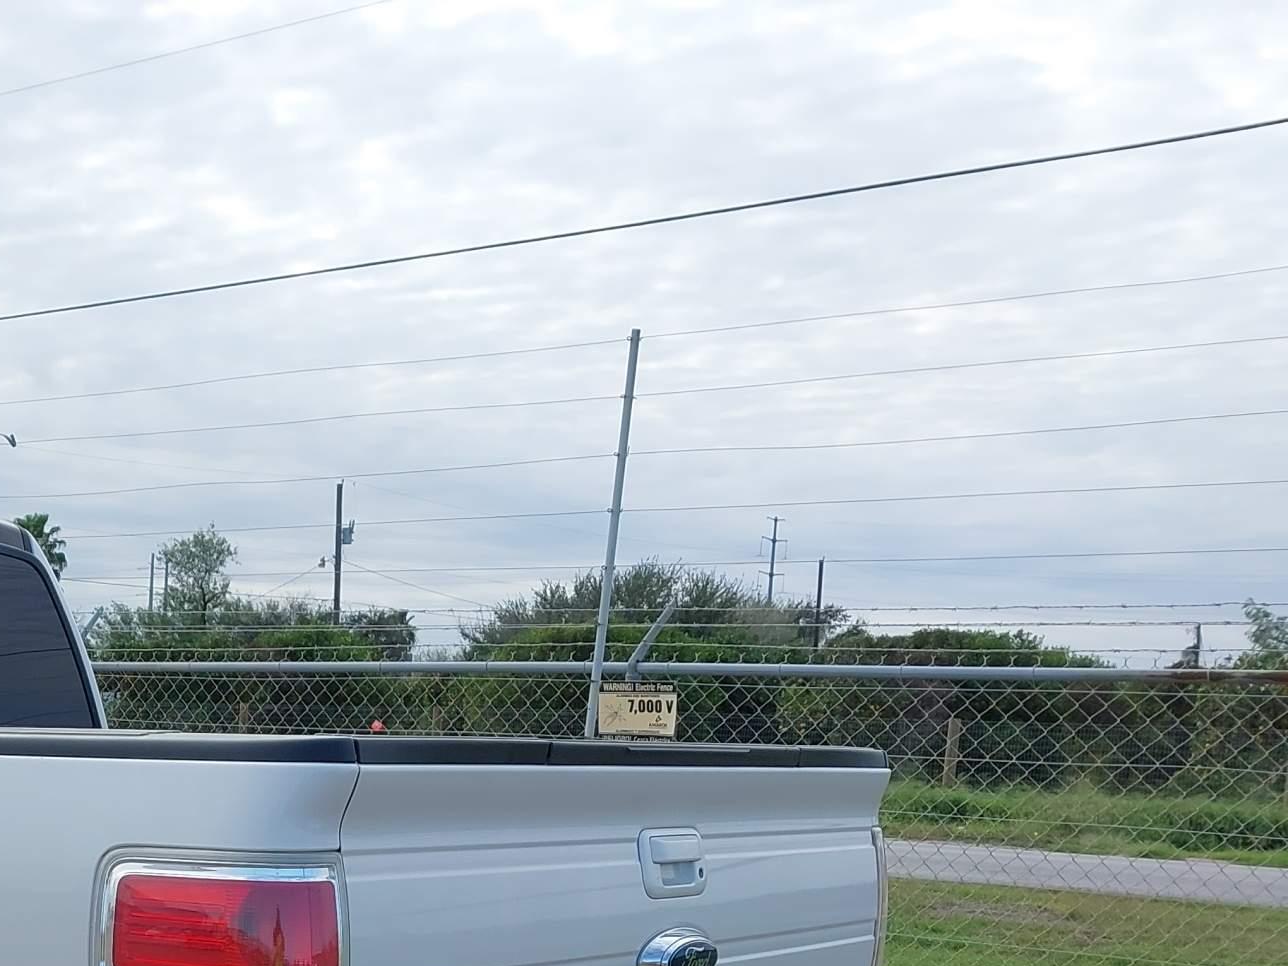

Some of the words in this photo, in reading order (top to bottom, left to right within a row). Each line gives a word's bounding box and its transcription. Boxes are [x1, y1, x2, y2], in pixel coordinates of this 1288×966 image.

[603, 683, 634, 691] WARNING!
[635, 682, 656, 691] Electric
[657, 683, 673, 691] Fence
[628, 699, 662, 714] 7,000
[666, 700, 674, 713] V
